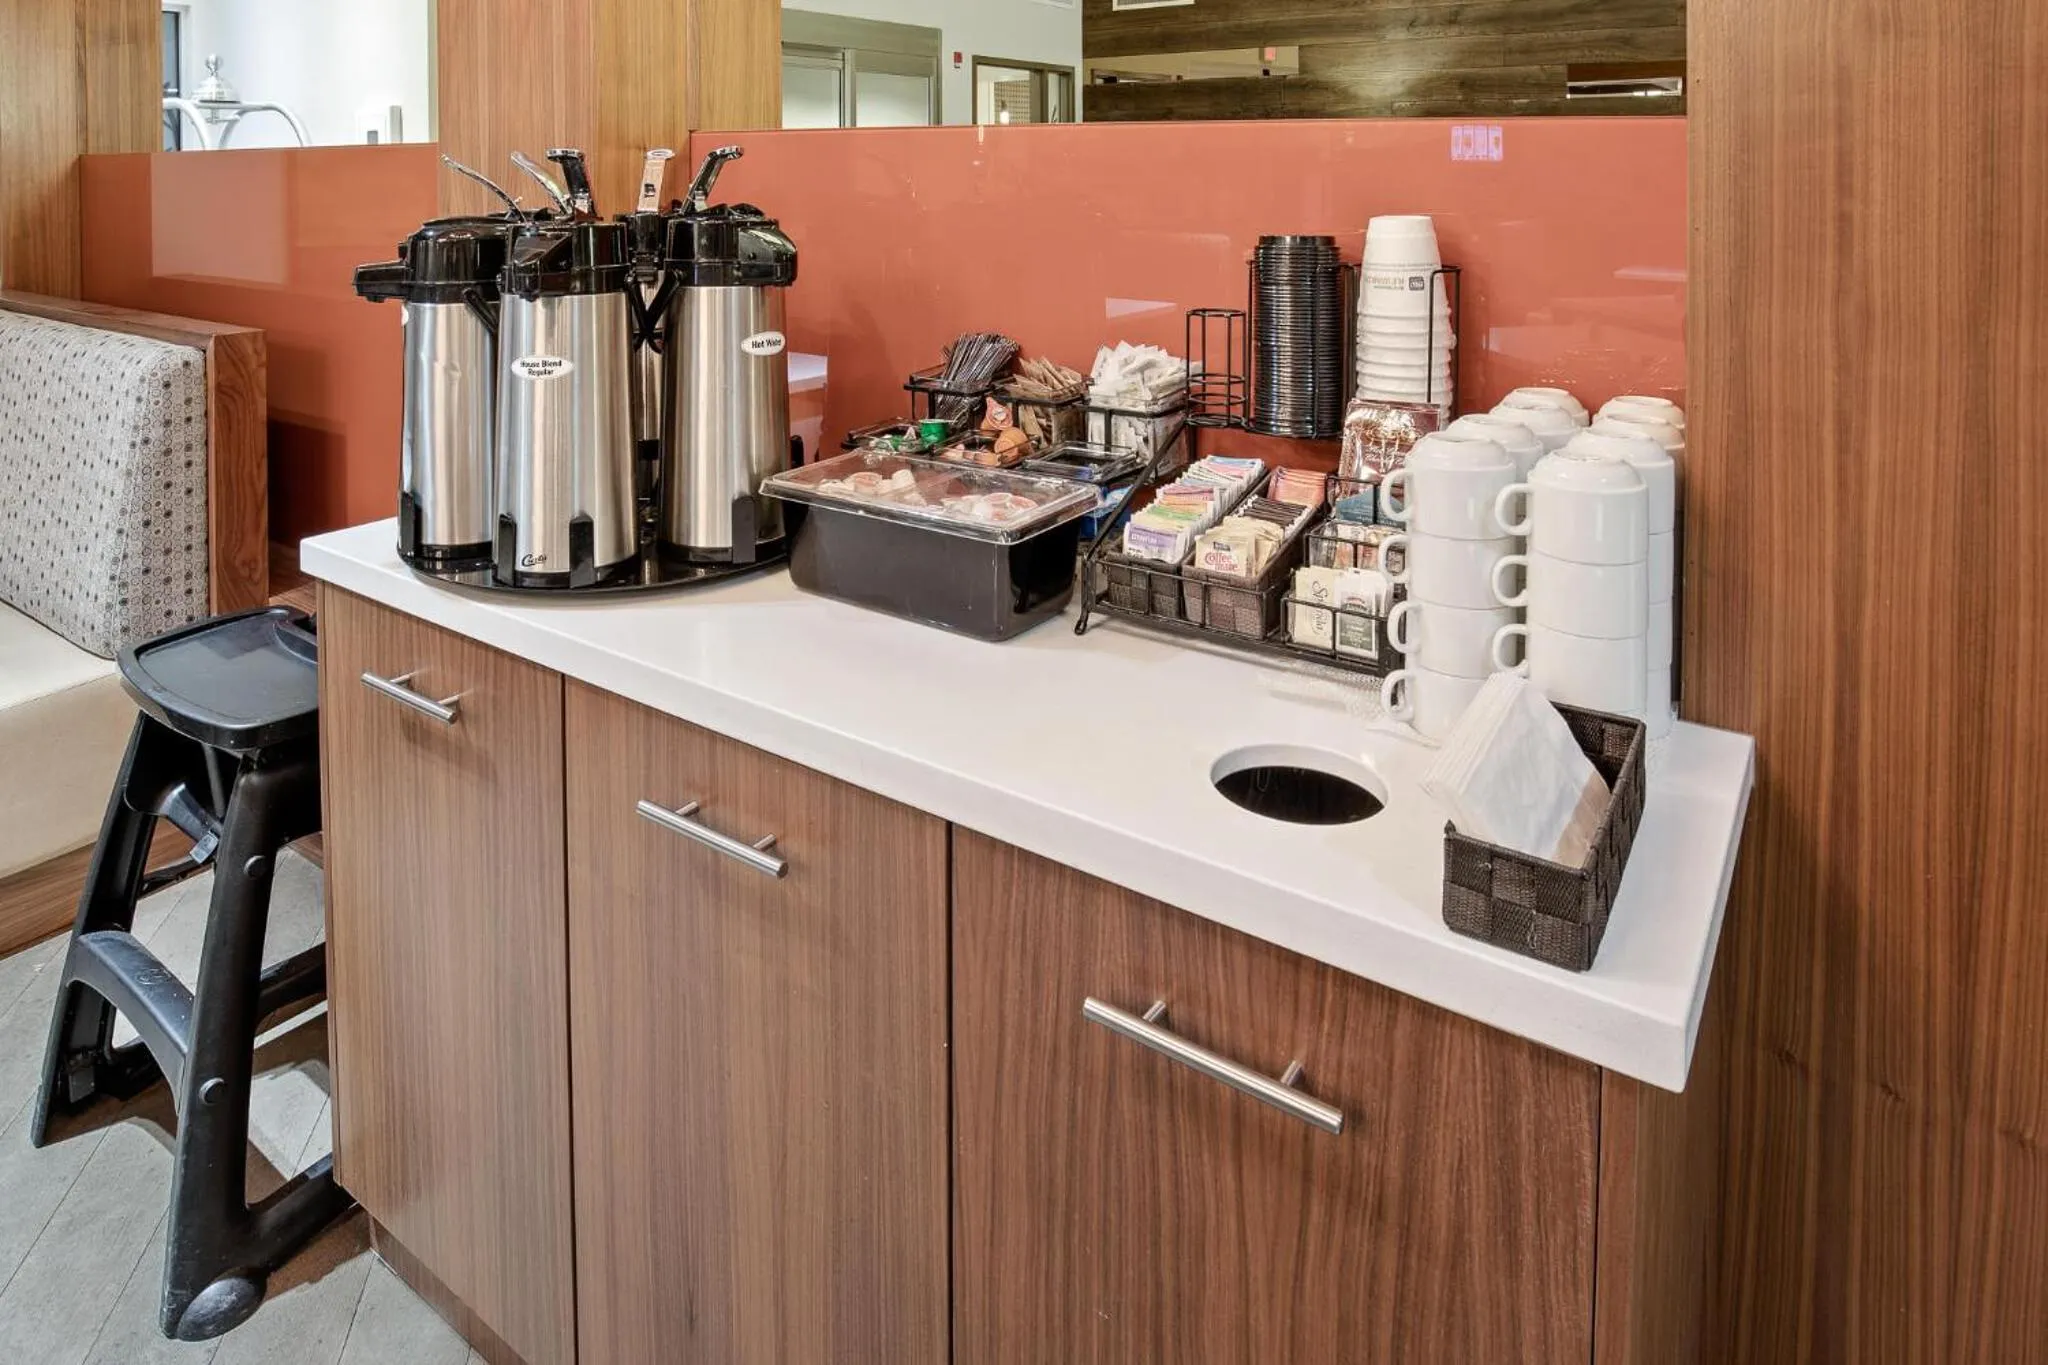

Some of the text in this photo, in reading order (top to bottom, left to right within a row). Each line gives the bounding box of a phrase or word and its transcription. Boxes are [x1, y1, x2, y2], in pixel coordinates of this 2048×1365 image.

[751, 340, 765, 349] Hot
[520, 360, 562, 368] House Blend
[527, 368, 554, 377] Regular
